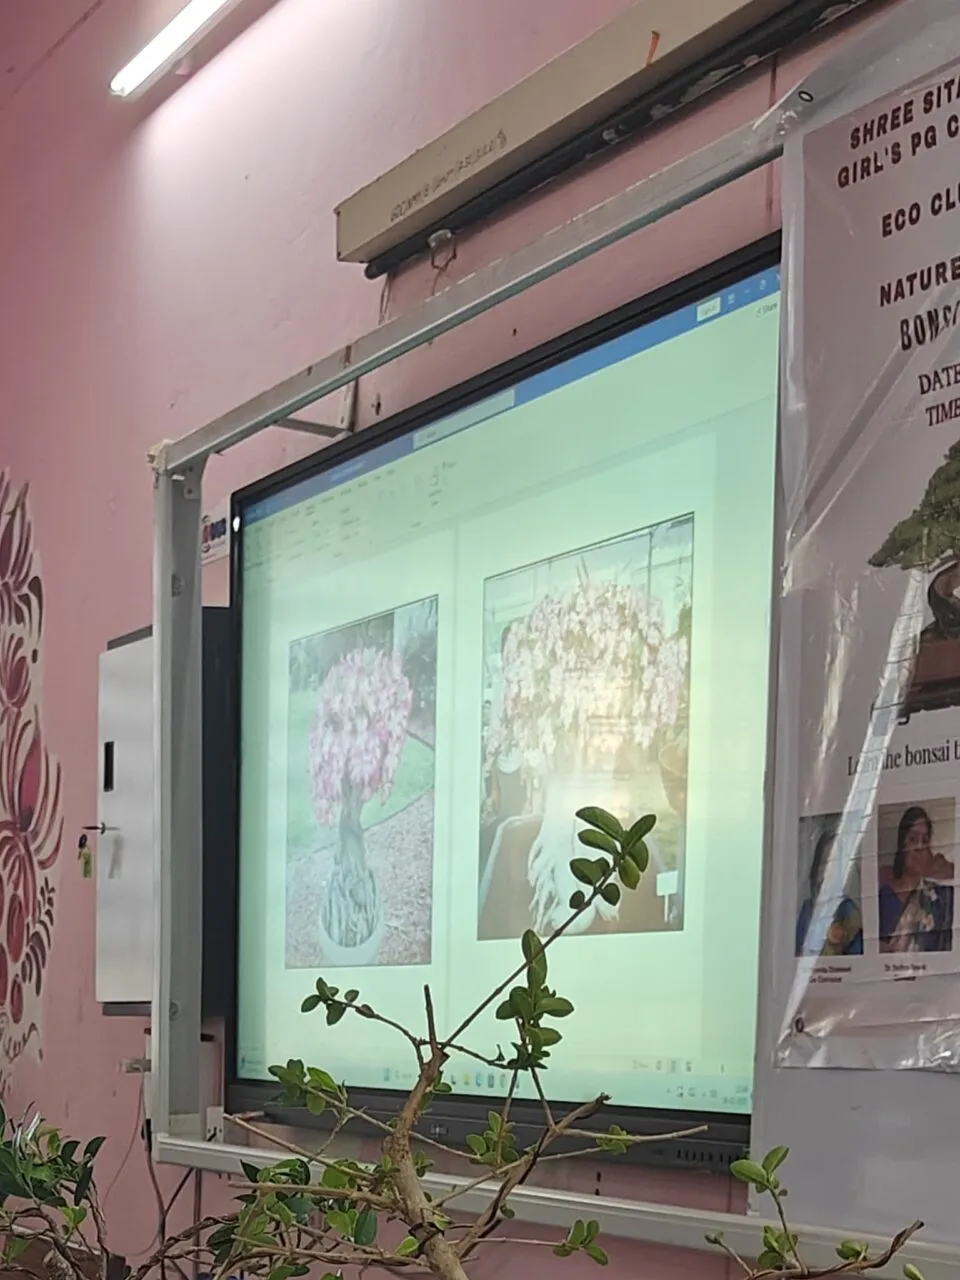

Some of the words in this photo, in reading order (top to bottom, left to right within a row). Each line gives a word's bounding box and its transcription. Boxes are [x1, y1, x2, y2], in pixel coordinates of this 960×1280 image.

[850, 100, 914, 149] SHREE
[923, 76, 960, 114] SIT
[837, 141, 902, 188] GIRL'S
[911, 125, 937, 156] PG
[882, 202, 921, 237] ECO
[931, 183, 960, 216] CL
[880, 255, 960, 307] NATURE
[918, 363, 960, 395] DATE
[925, 398, 960, 426] TIME
[881, 748, 901, 770] he
[905, 739, 950, 767] bonsai
